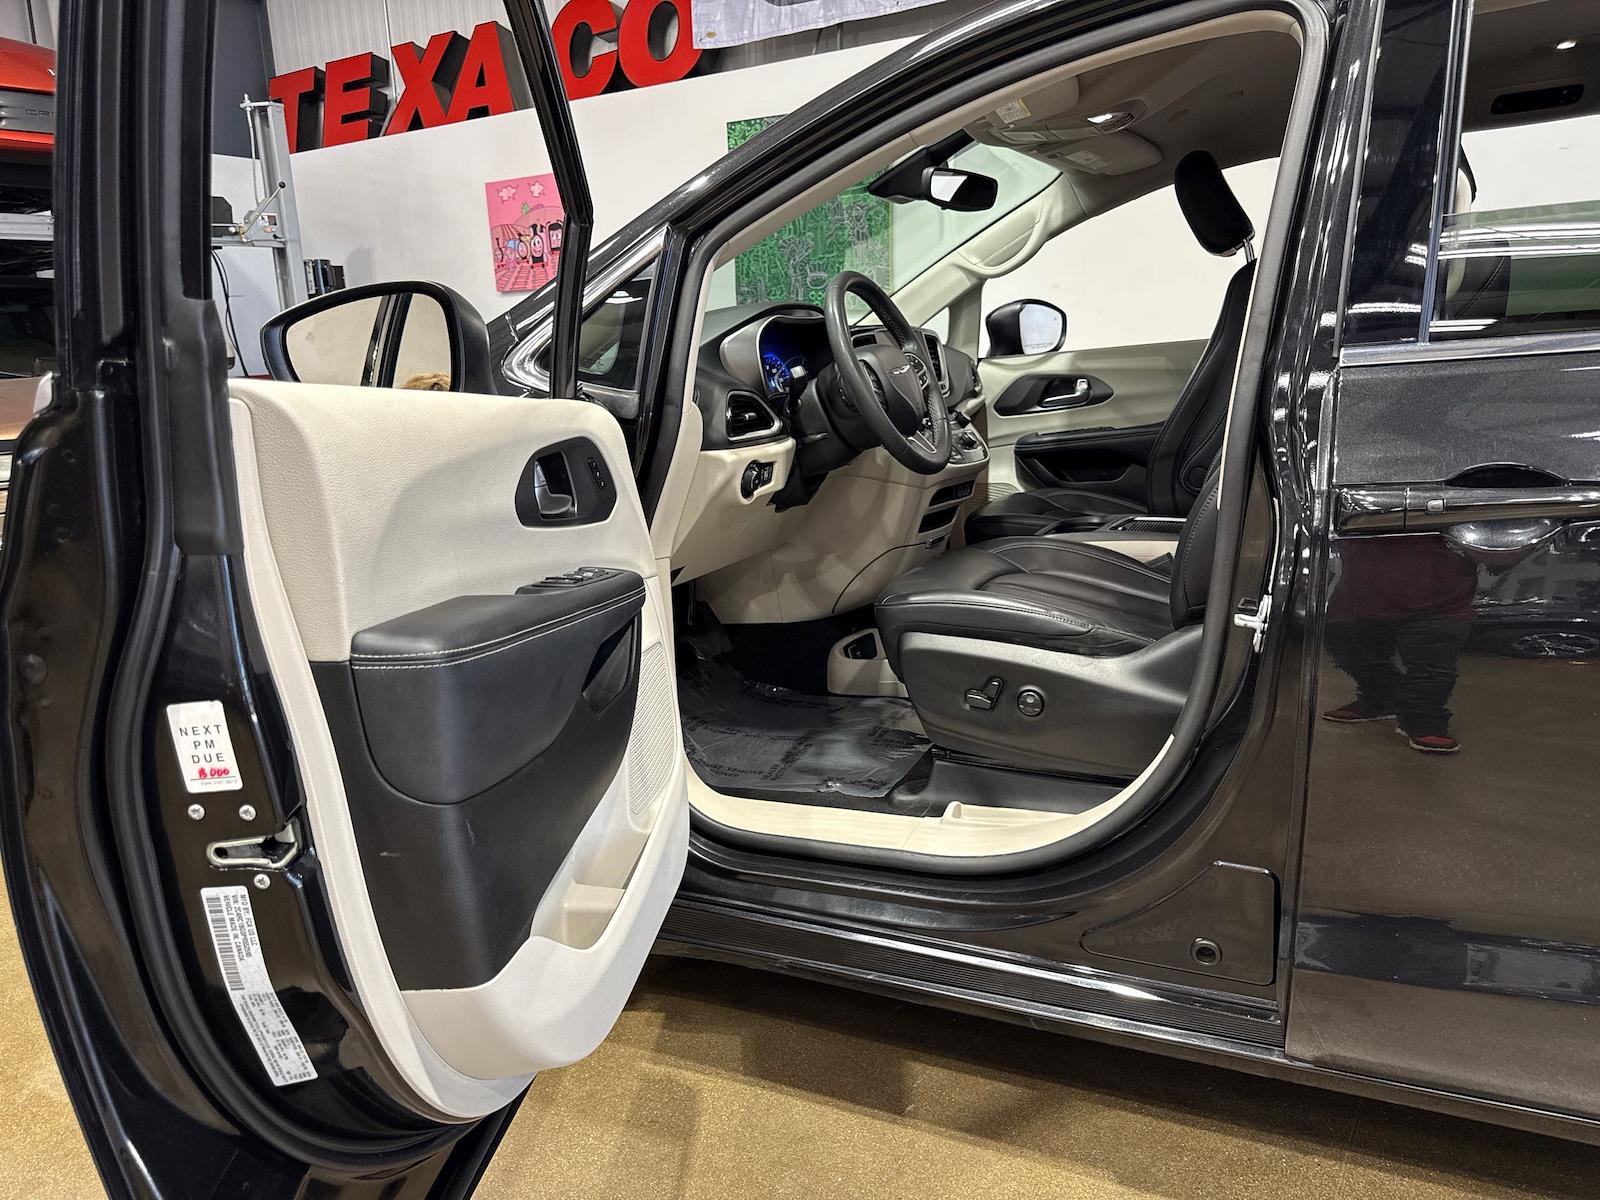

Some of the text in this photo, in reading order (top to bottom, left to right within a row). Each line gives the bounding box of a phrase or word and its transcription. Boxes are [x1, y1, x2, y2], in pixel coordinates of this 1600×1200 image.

[269, 0, 700, 153] TEXACO
[179, 724, 221, 737] NEXT
[193, 739, 215, 750] PM
[191, 752, 225, 764] DUE
[223, 895, 234, 916] VEHICLE
[228, 917, 238, 931] MADE
[234, 941, 245, 961] CANADA
